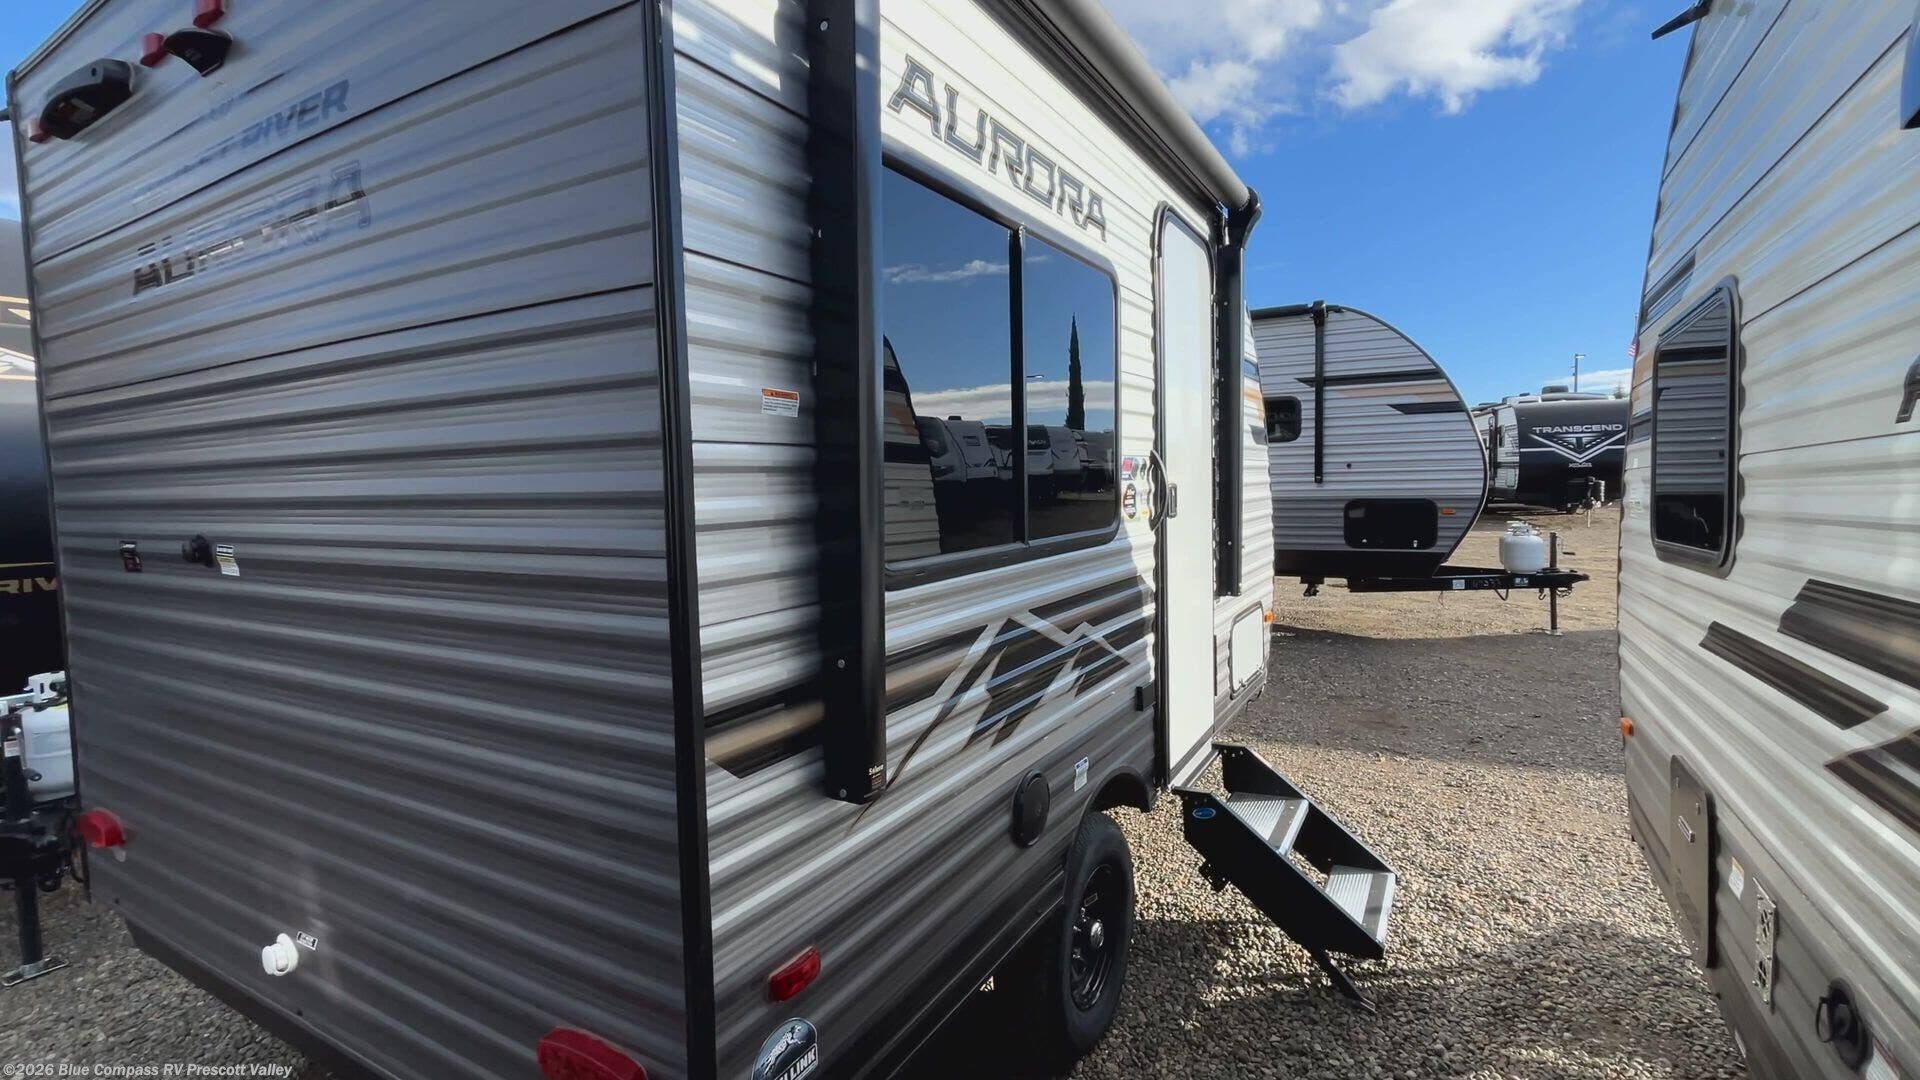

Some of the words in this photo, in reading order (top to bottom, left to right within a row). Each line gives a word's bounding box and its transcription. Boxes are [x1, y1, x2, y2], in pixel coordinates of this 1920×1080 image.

[887, 53, 1107, 243] AURORA
[1532, 423, 1623, 433] TRANSCEND
[789, 1047, 816, 1080] LINK
